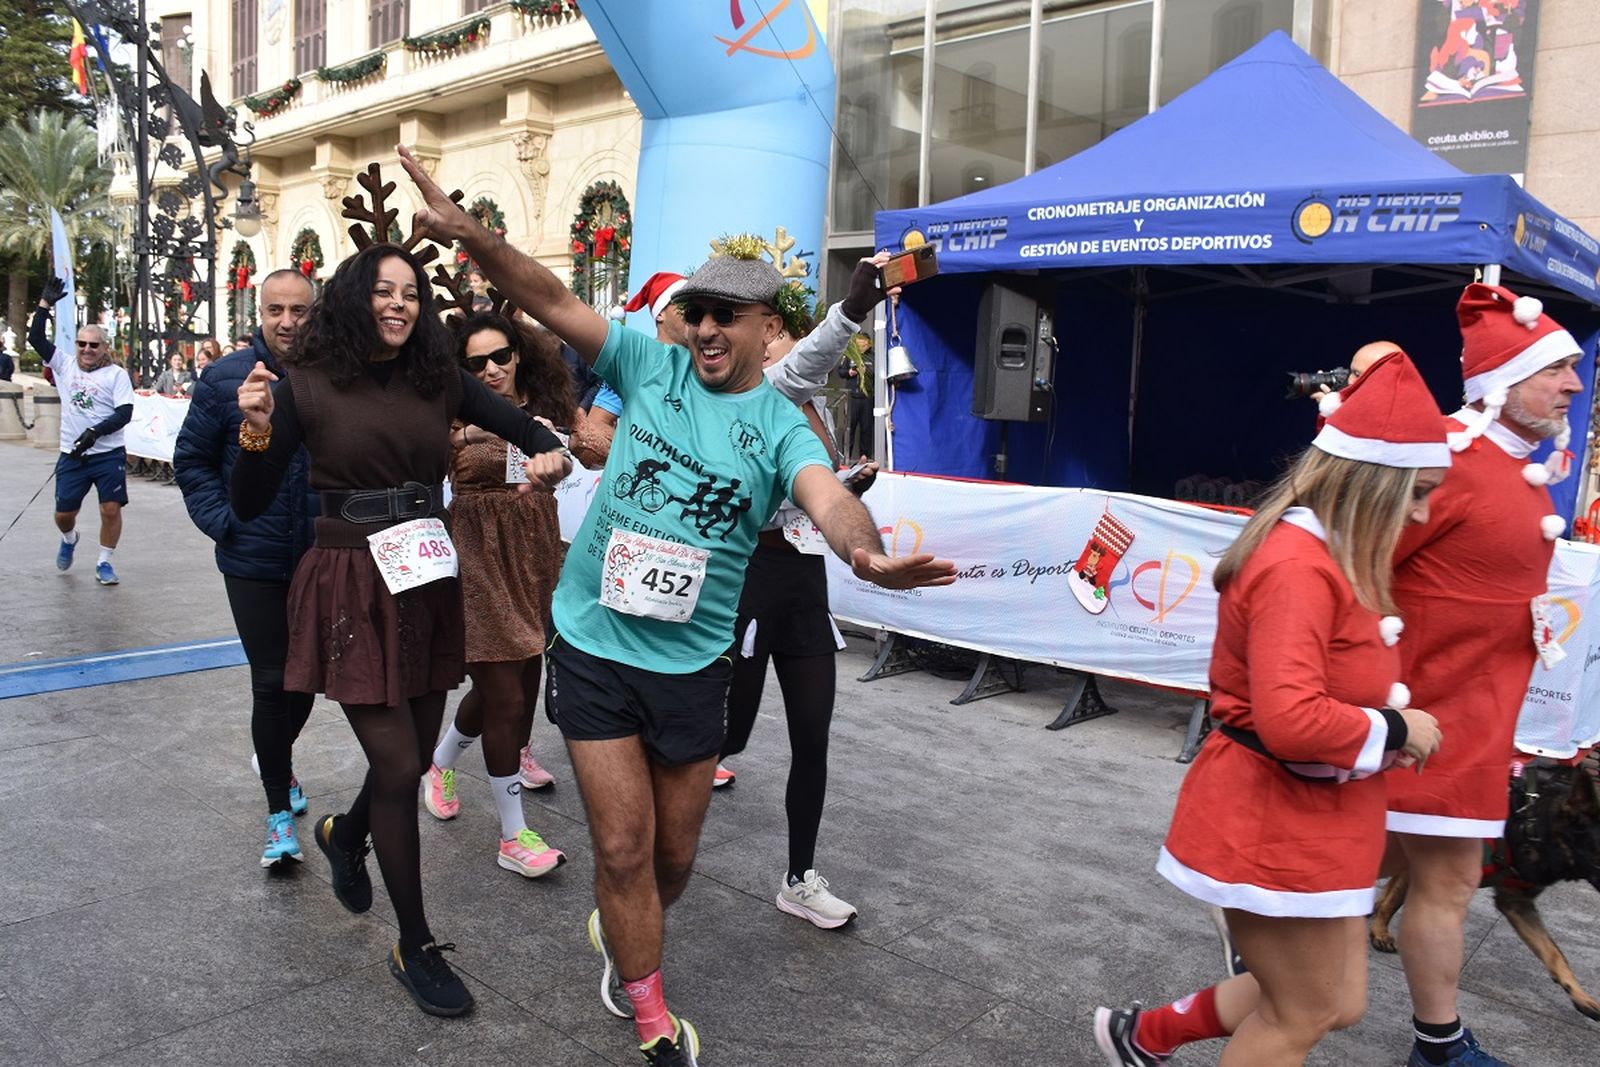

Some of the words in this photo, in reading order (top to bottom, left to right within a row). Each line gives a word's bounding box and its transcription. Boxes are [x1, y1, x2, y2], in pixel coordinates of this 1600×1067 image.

[1428, 130, 1509, 145] ceuta.ebiblio.es
[1027, 199, 1141, 221] CRONOMETRAJE
[1143, 191, 1265, 212] ORGANIZACIÓN
[1336, 193, 1372, 207] MIS
[1377, 191, 1463, 207] TIEMPOS
[1134, 219, 1145, 232] Y
[1367, 207, 1460, 232] CHIP
[949, 229, 1008, 251] CHIP
[1019, 240, 1078, 258] GESTIÓN
[1080, 240, 1100, 254] DE
[1102, 236, 1168, 253] EVENTOS
[1171, 234, 1272, 251] DEPORTIVOS
[418, 540, 451, 559] 486
[991, 567, 1007, 578] es
[1011, 559, 1078, 584] Deport
[641, 568, 693, 597] 452
[1159, 630, 1196, 644] DEPORTES
[1526, 686, 1571, 701] EPORTES
